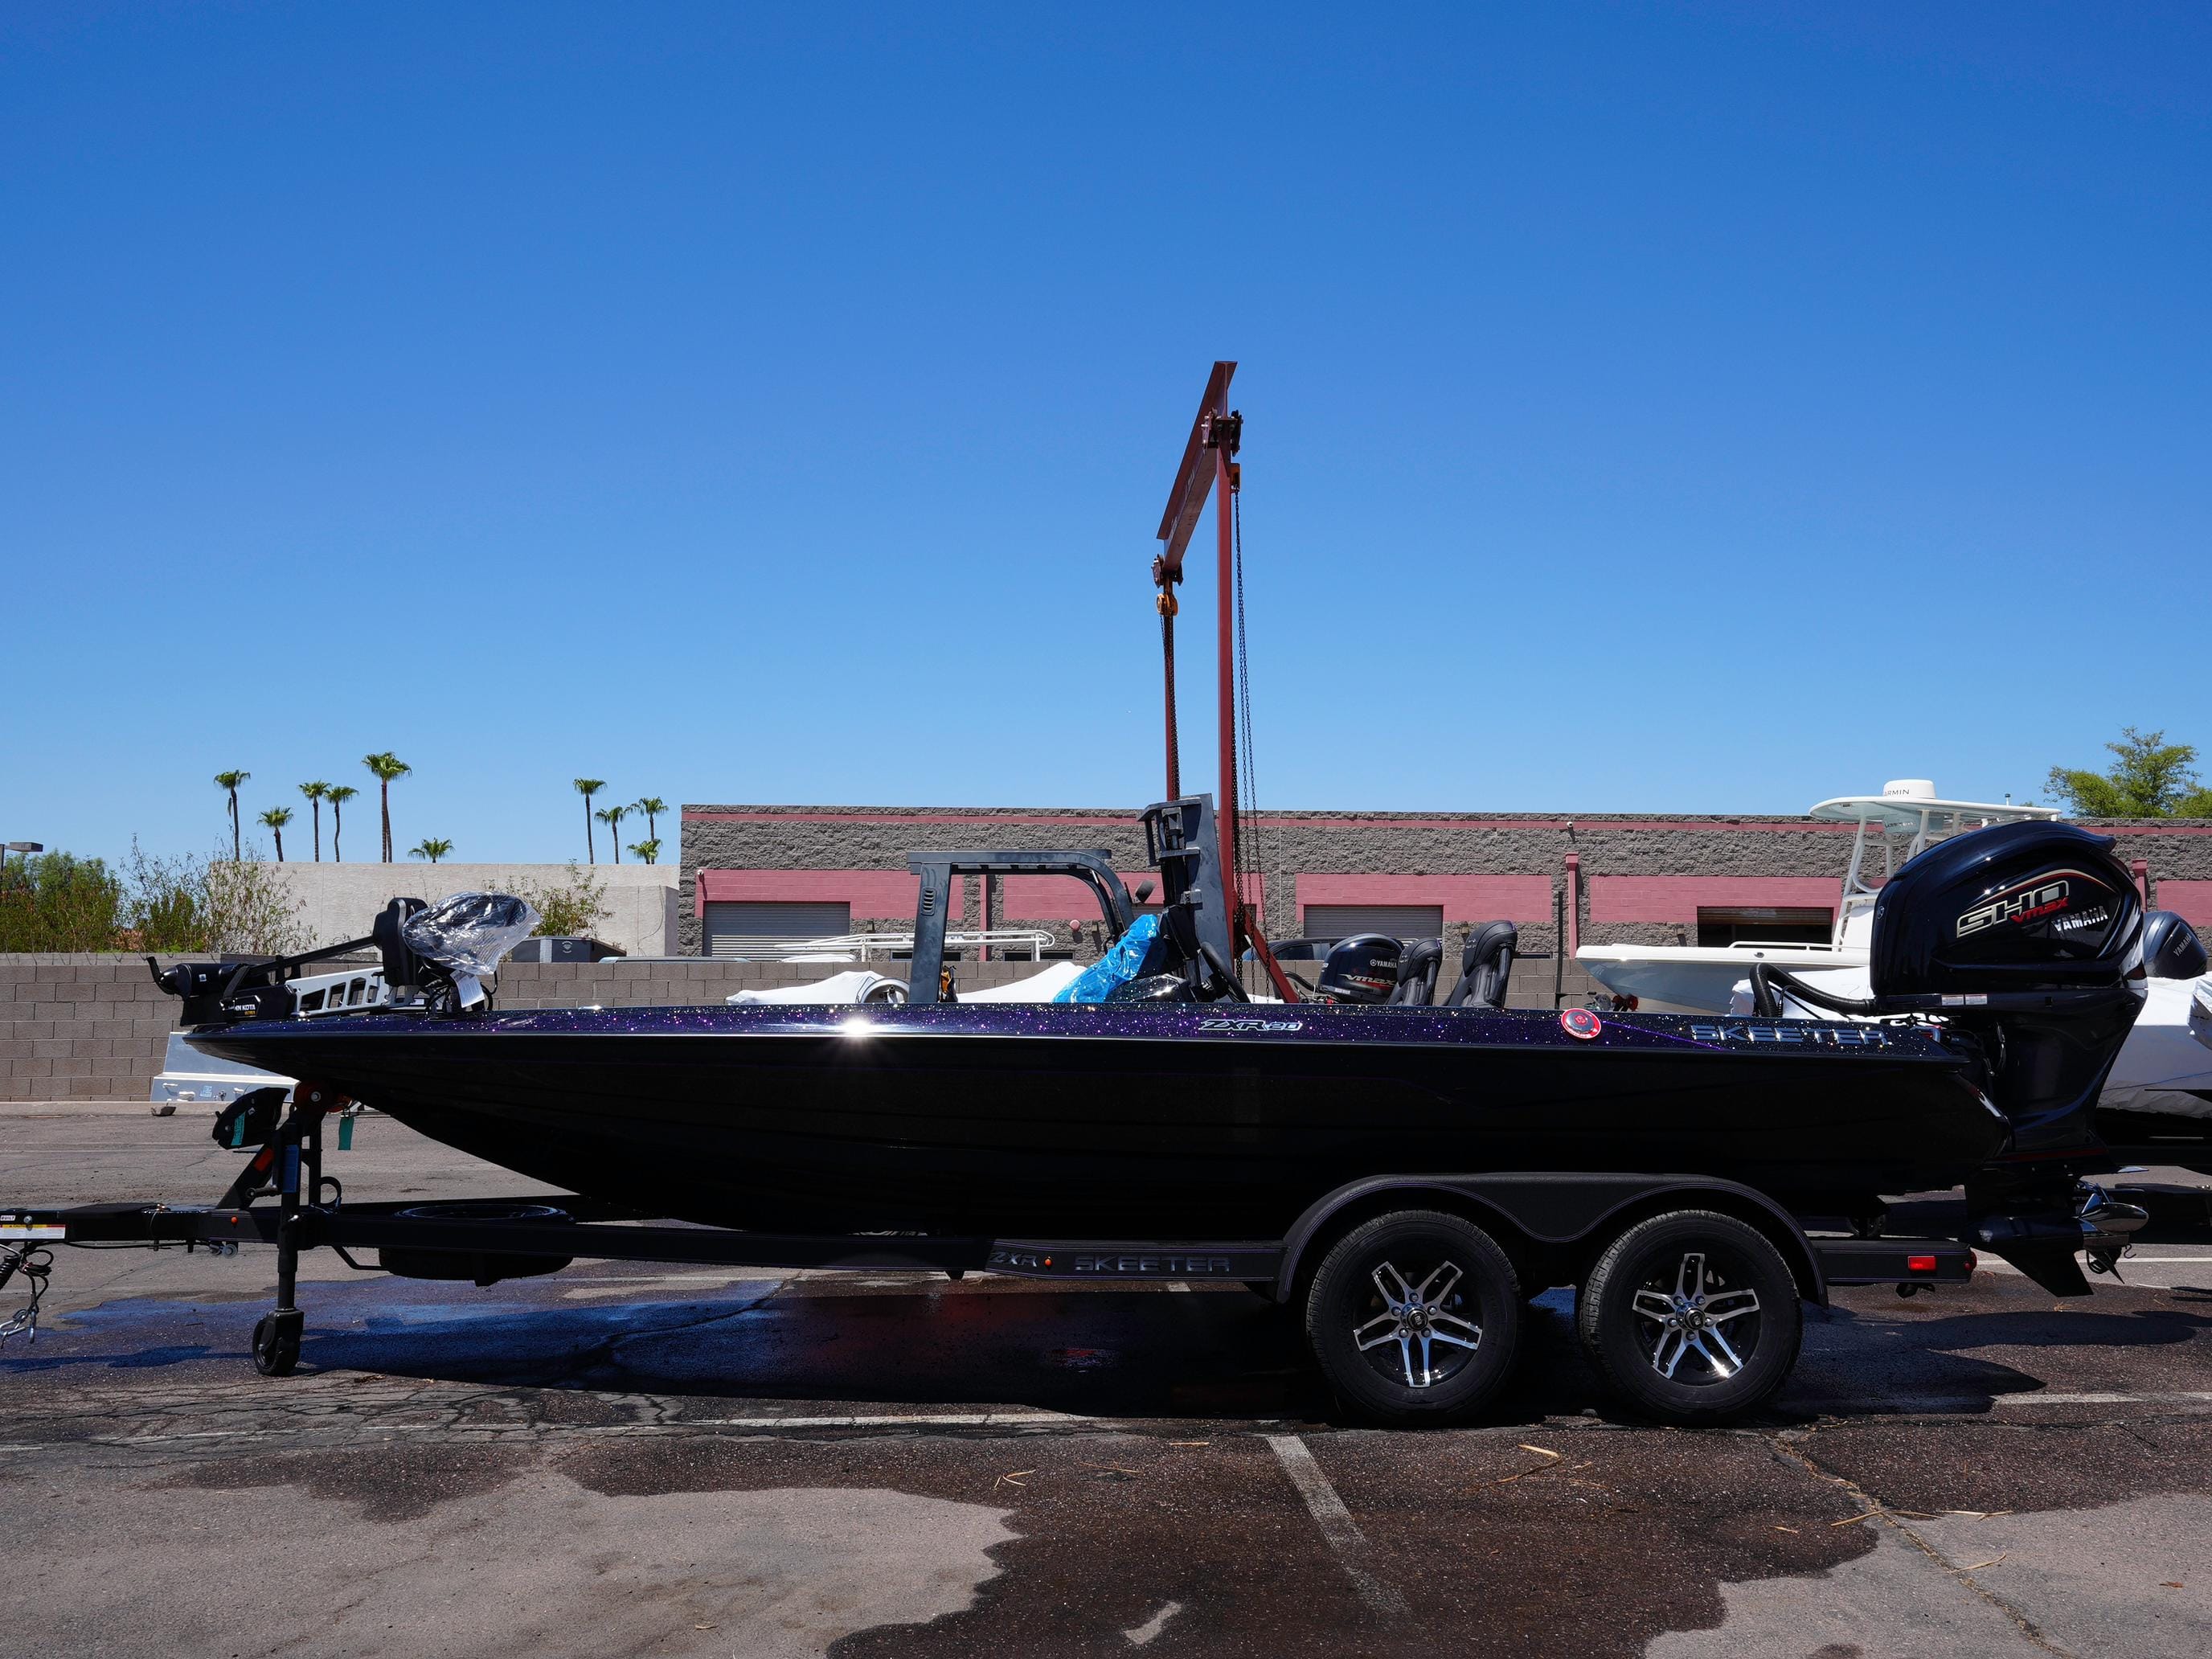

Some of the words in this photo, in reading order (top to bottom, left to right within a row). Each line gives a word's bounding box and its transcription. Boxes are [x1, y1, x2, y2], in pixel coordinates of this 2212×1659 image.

[1884, 789, 1910, 797] ARMIN
[1956, 880, 2070, 939] SHO
[2051, 906, 2108, 932] YAMAHA
[1198, 1018, 1268, 1030] ZXR
[1268, 1022, 1302, 1030] 20
[1691, 1025, 1887, 1045] SKEETER
[1075, 1256, 1230, 1272] SKEETER
